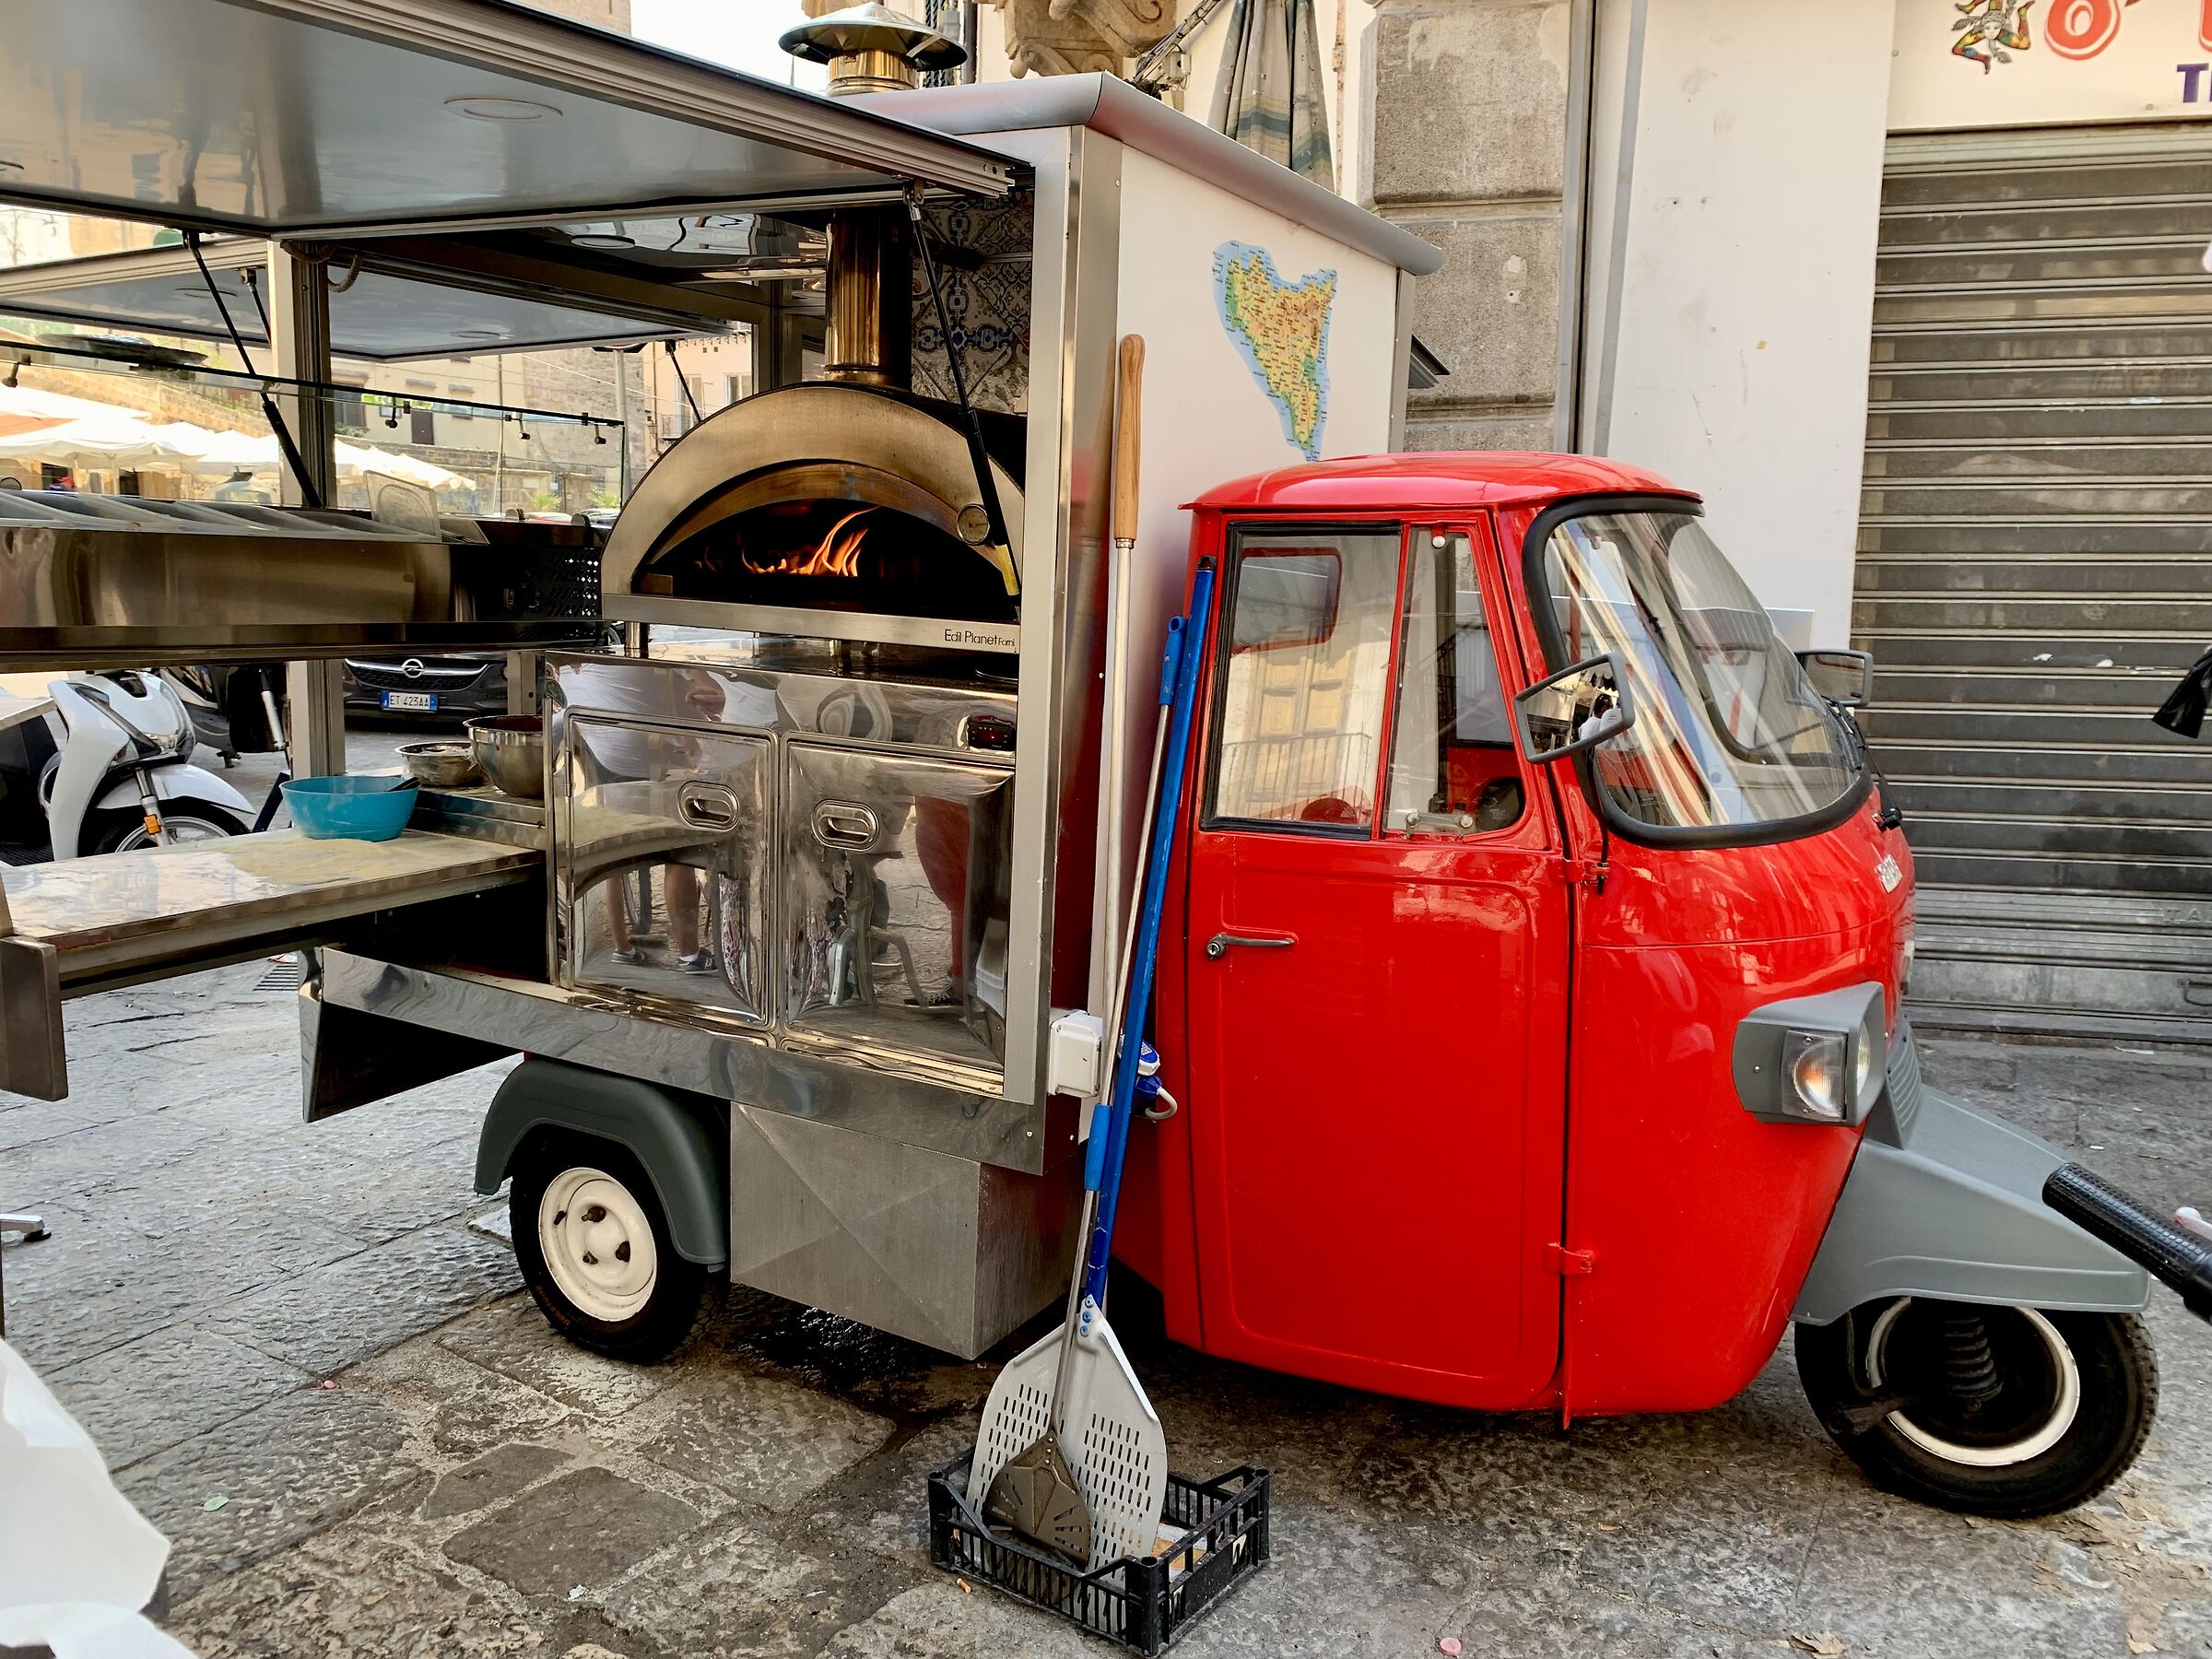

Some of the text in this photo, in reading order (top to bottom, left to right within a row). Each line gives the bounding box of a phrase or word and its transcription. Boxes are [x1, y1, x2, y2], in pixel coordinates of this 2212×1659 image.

[2176, 63, 2212, 103] T
[945, 629, 962, 642] Edil
[964, 630, 997, 645] Planet
[390, 695, 400, 705] ET
